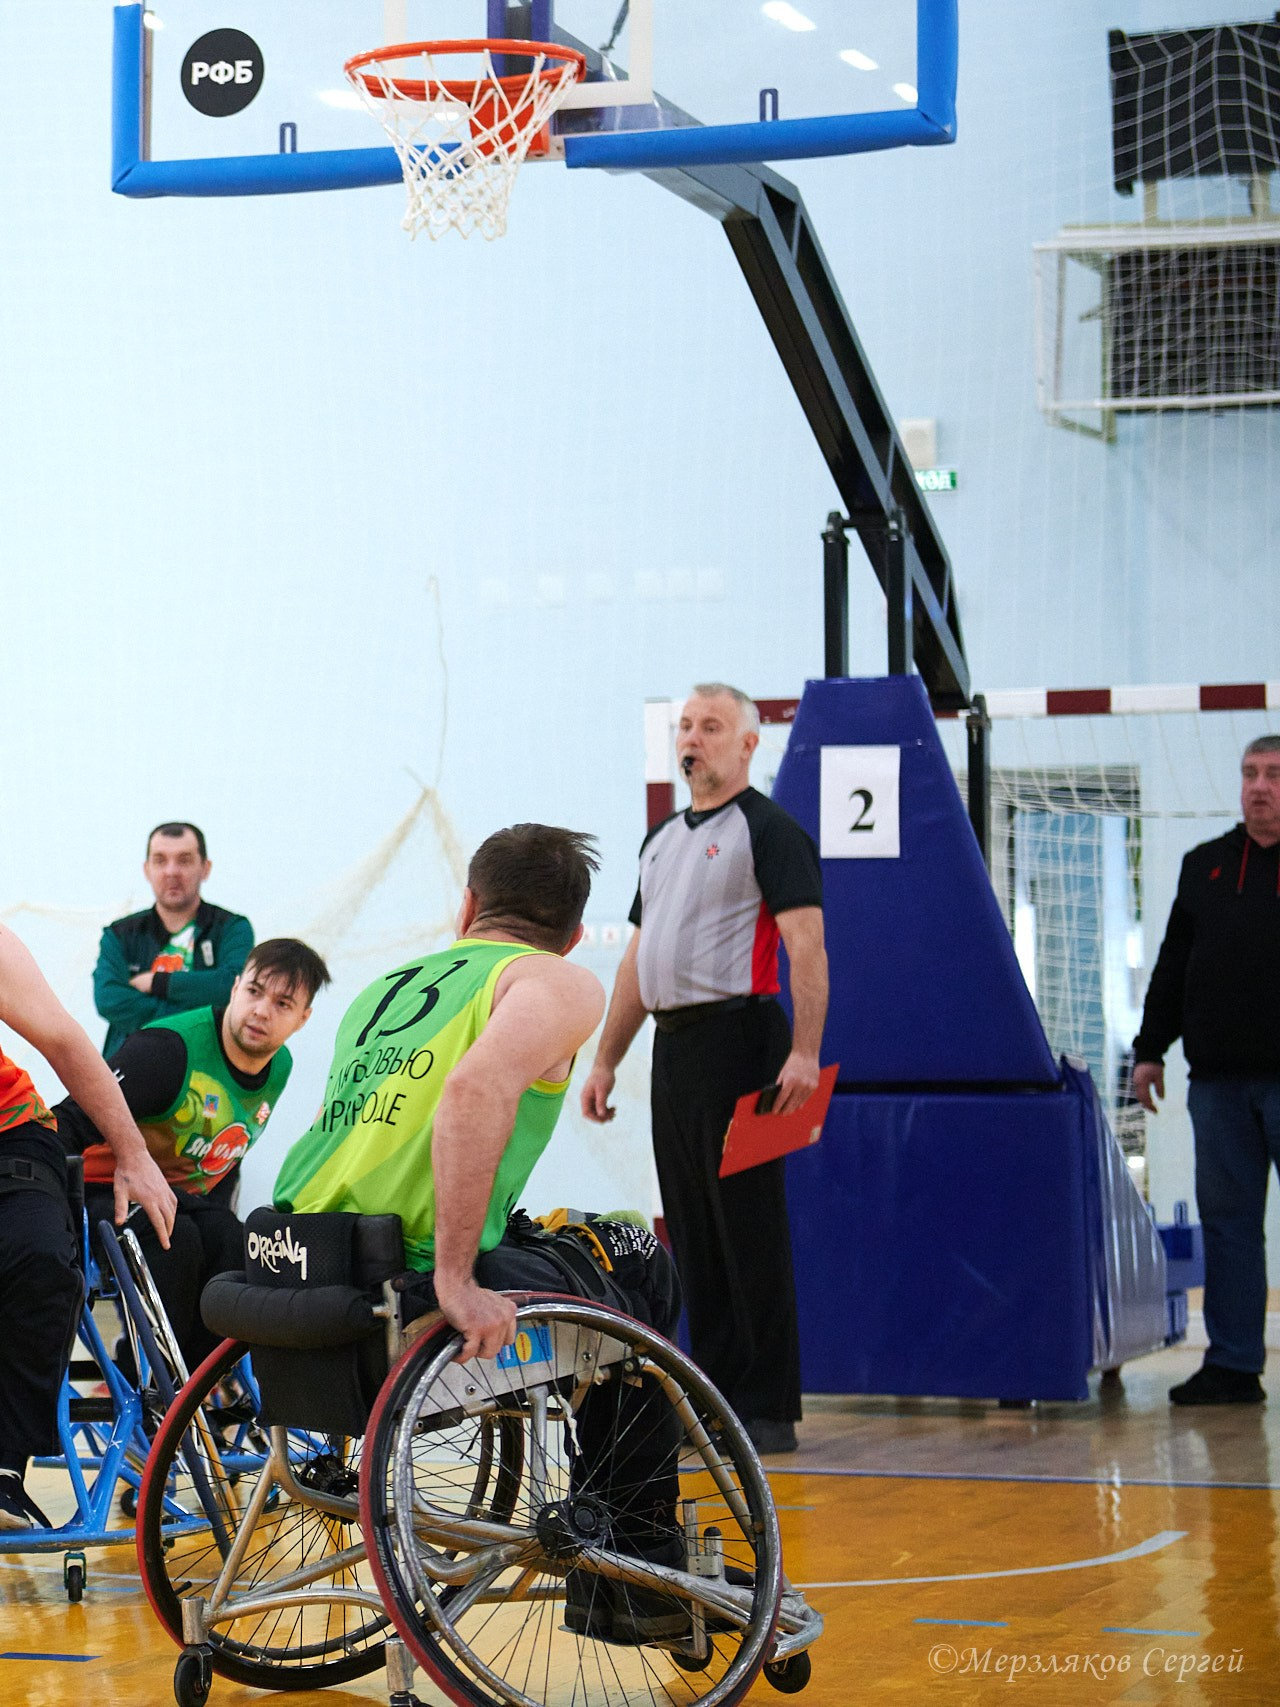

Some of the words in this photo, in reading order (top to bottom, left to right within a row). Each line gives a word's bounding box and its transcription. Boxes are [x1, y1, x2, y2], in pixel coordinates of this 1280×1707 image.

[191, 60, 253, 85] РФБ
[848, 787, 875, 833] 2
[355, 959, 469, 1047] 13
